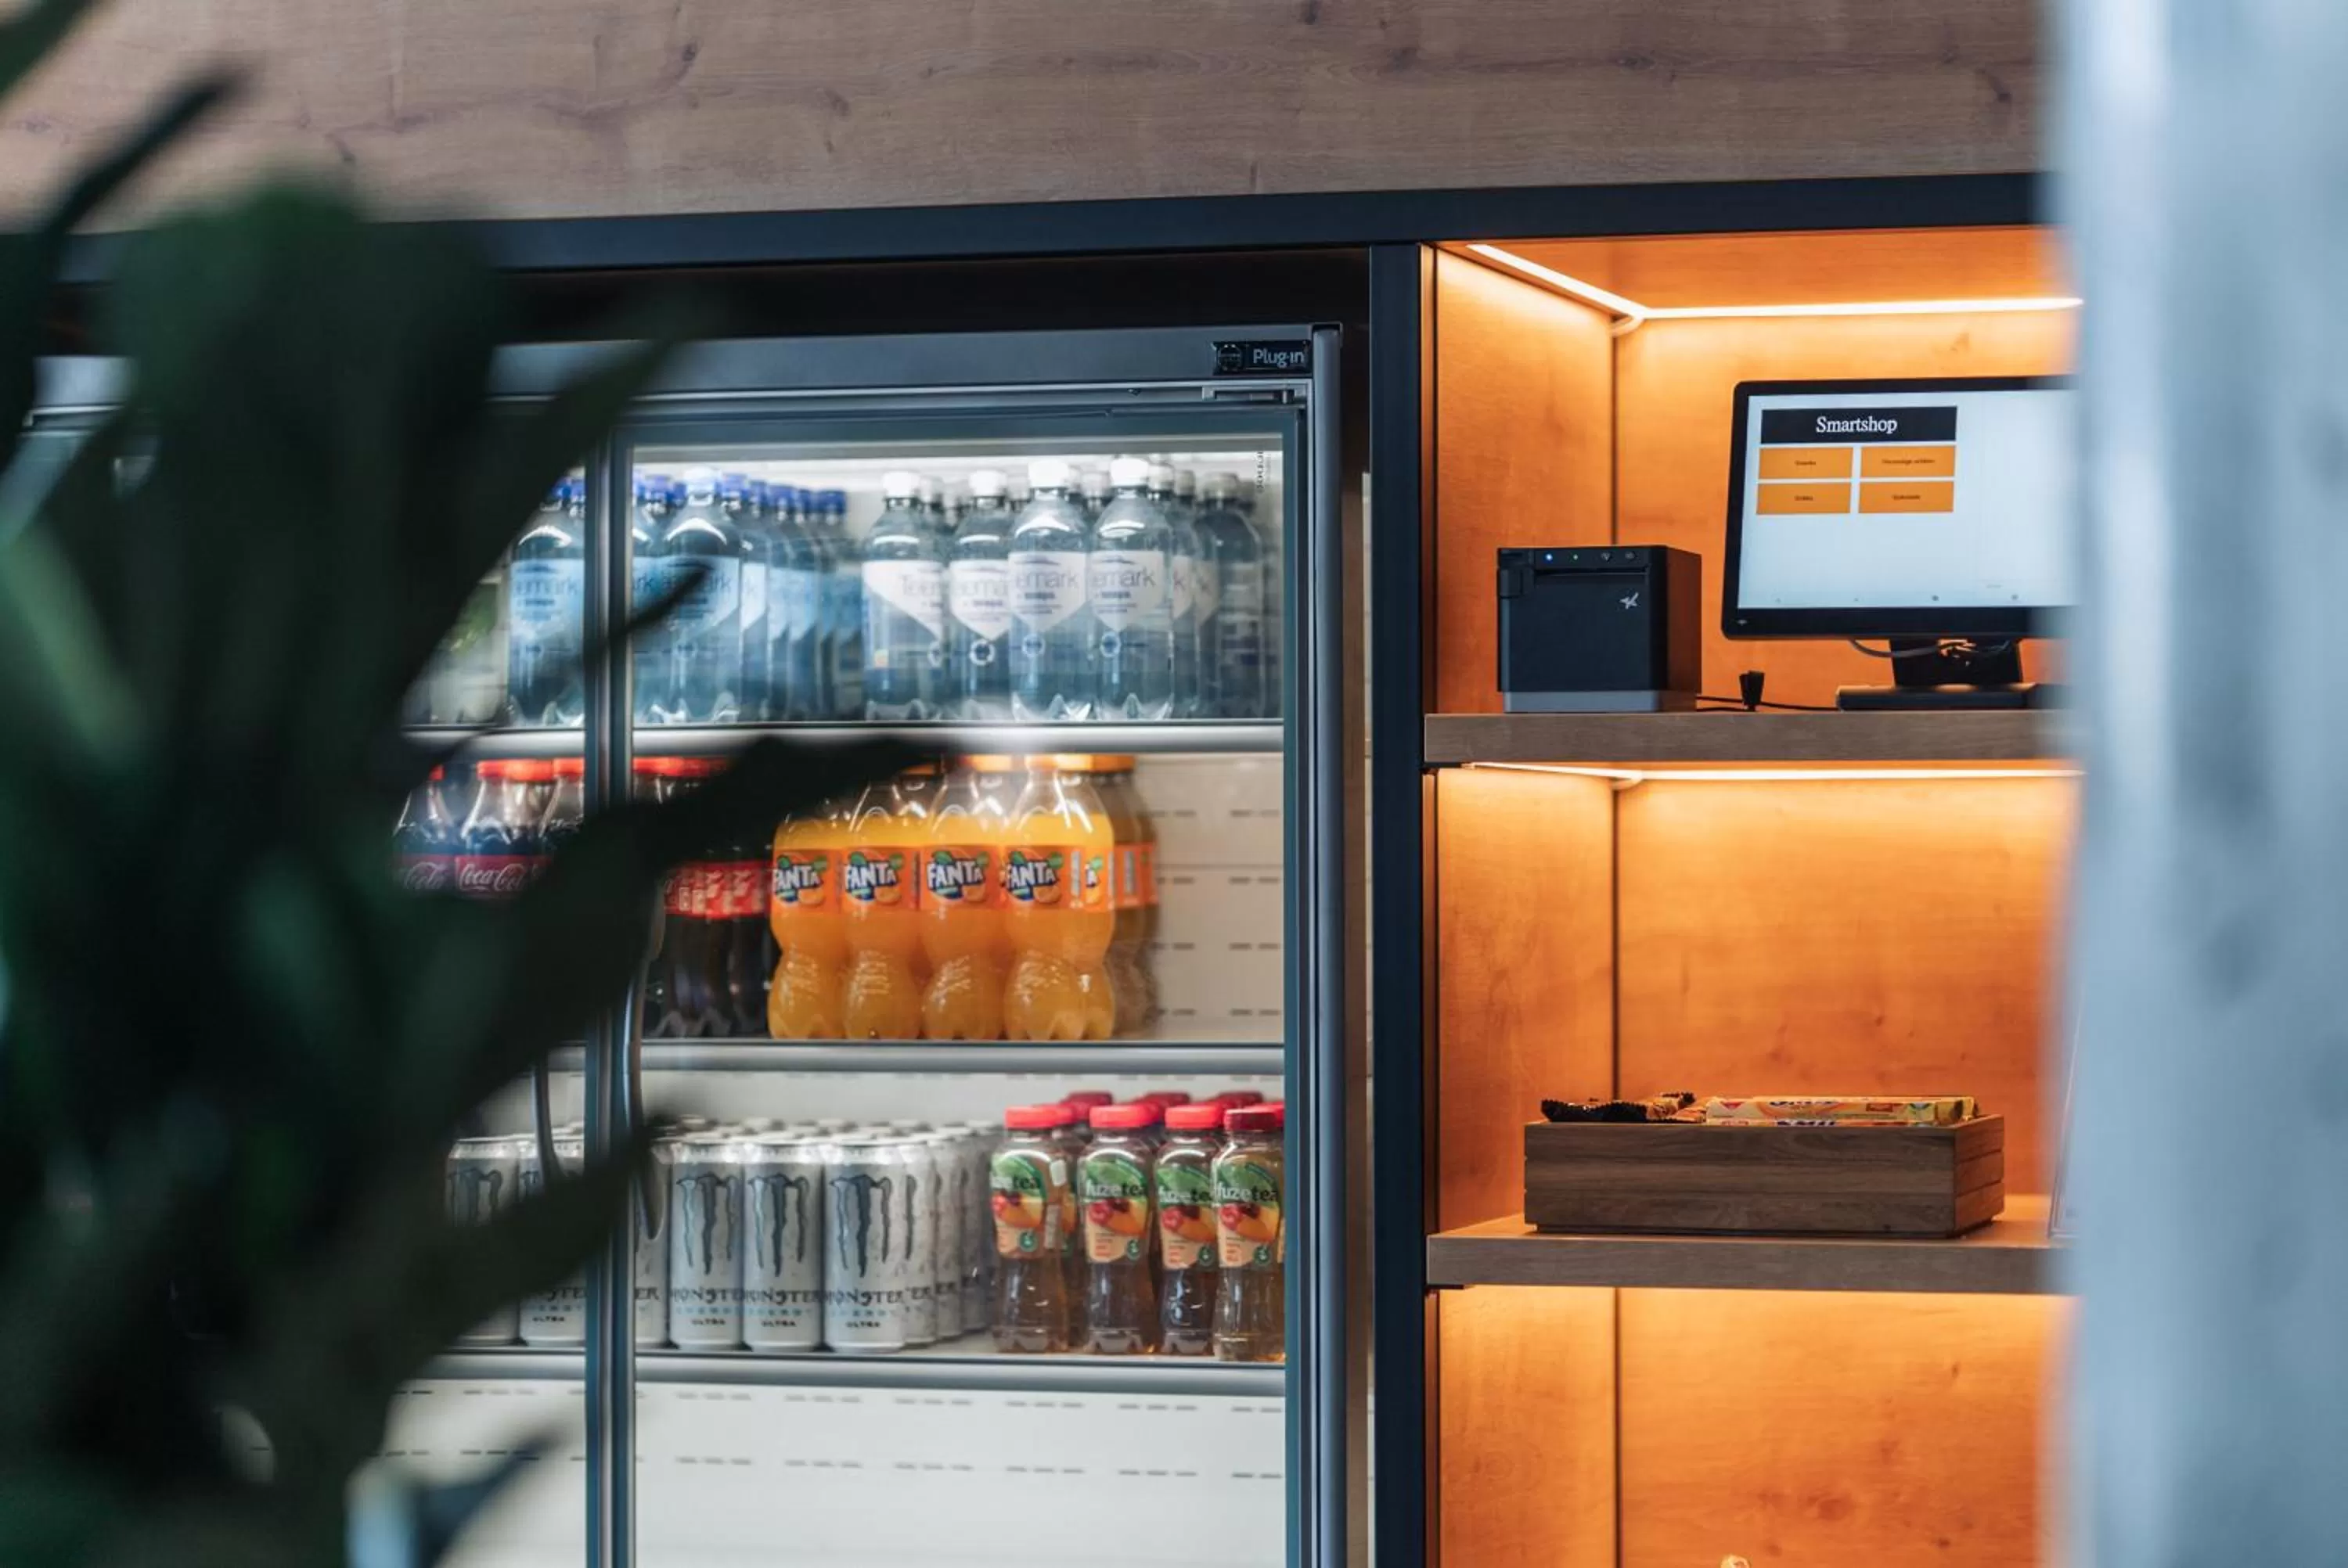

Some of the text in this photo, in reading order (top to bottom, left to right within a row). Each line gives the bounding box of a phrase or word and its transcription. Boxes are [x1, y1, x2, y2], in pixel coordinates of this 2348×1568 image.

[1816, 415, 1898, 434] Smartshop
[844, 861, 897, 890] FANTA
[927, 860, 983, 890] FANTA
